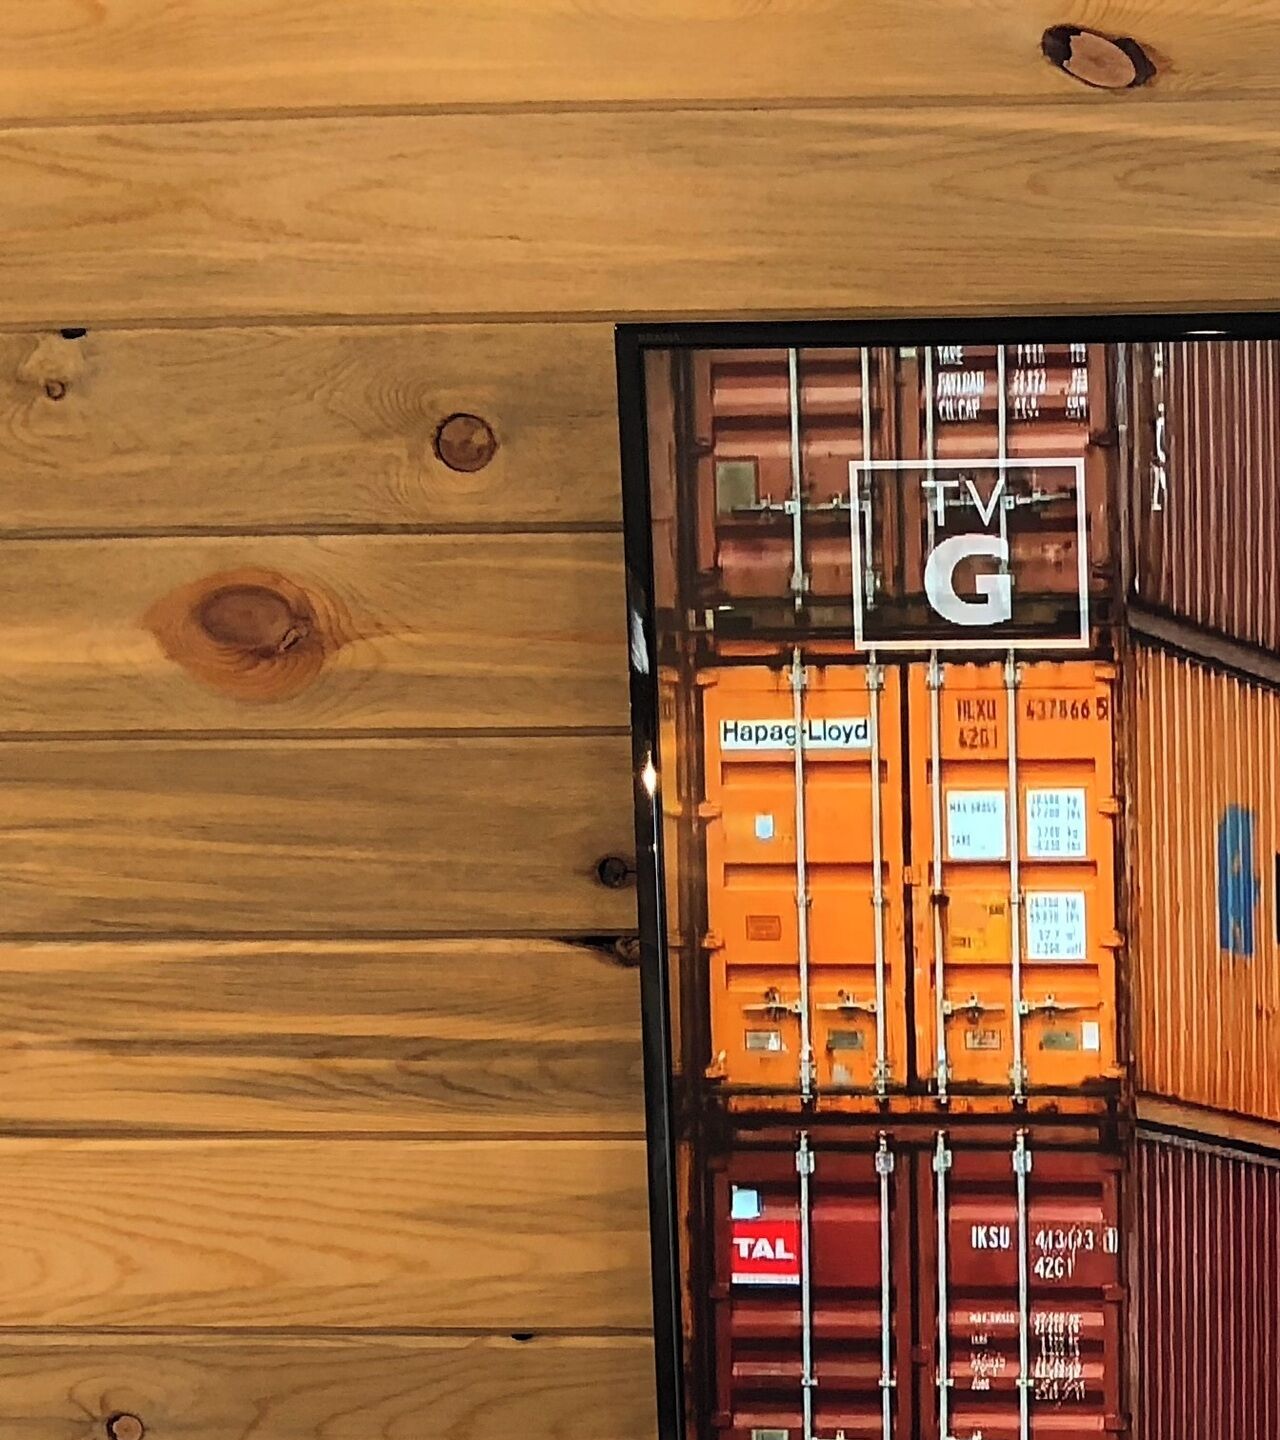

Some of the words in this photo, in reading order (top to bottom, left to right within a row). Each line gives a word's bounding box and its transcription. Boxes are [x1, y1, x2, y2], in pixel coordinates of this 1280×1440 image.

[921, 479, 1006, 527] TV
[924, 533, 1013, 626] G
[722, 720, 869, 747] Hapag-Lloyd
[733, 1237, 795, 1261] TAL
